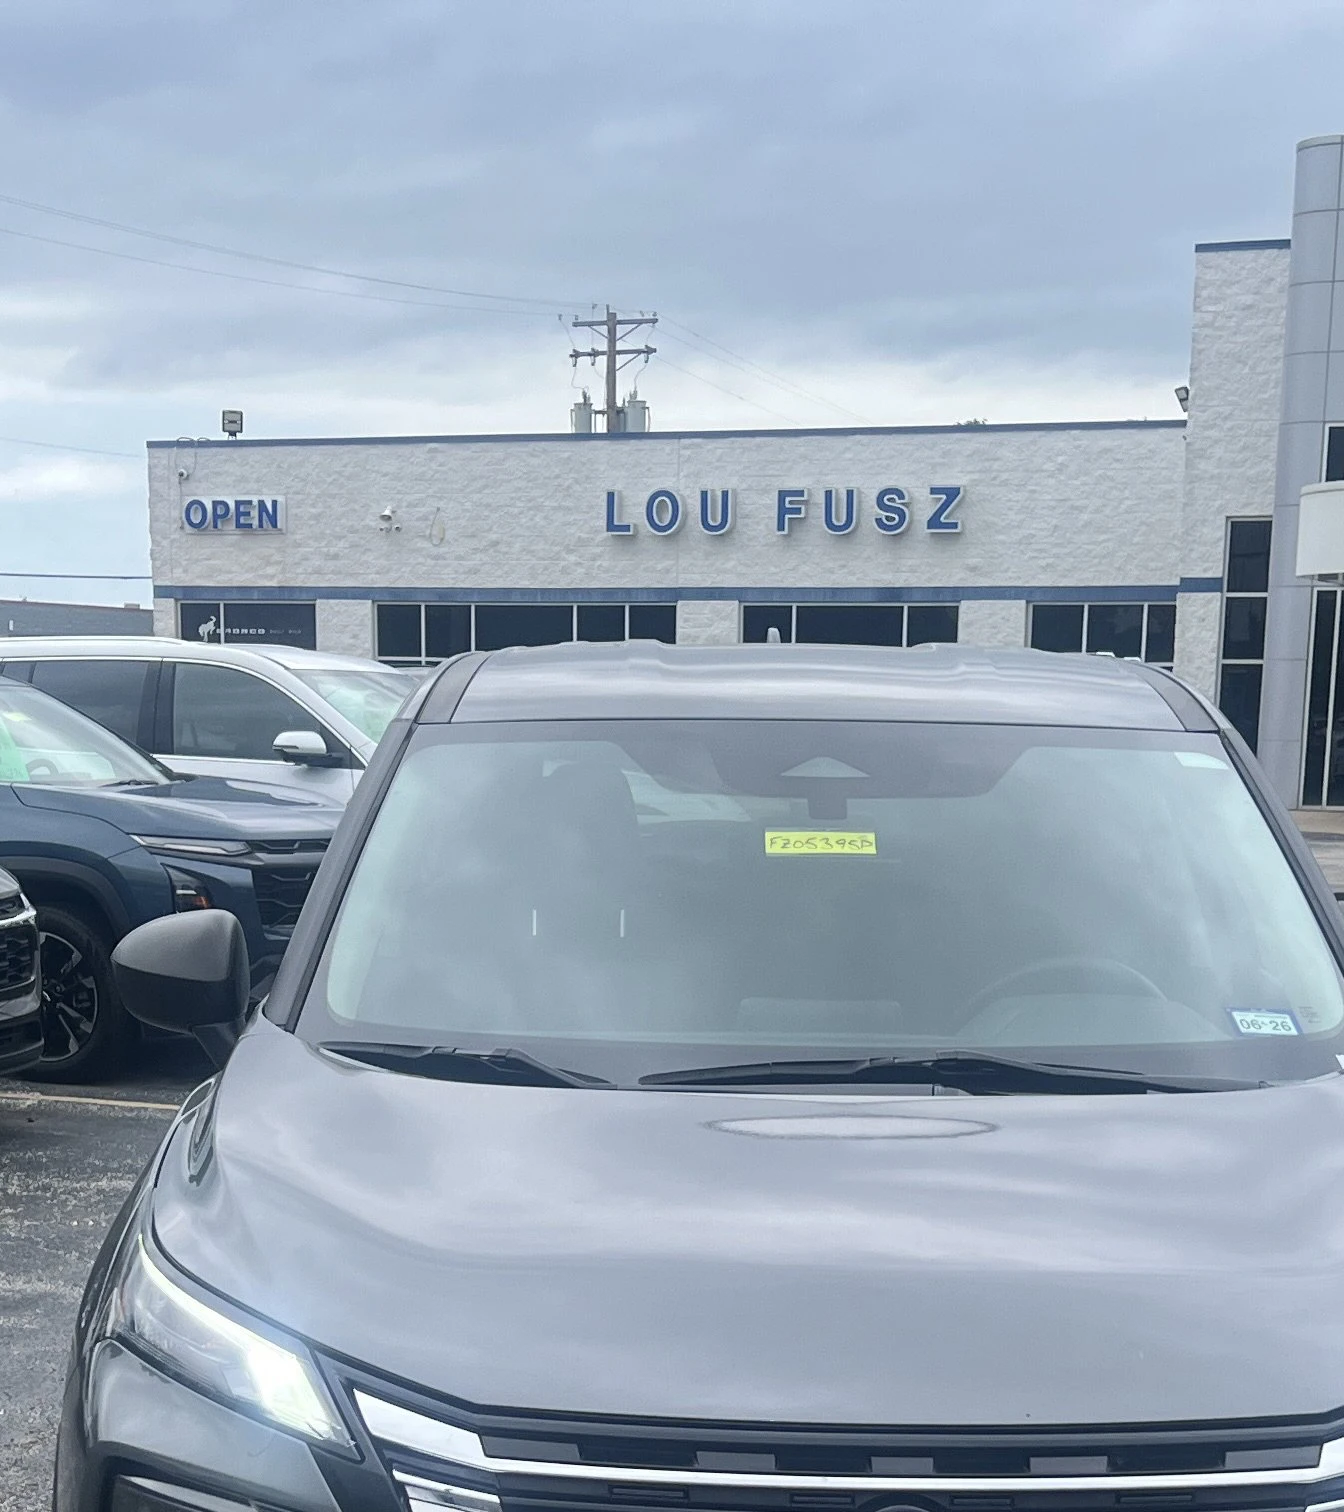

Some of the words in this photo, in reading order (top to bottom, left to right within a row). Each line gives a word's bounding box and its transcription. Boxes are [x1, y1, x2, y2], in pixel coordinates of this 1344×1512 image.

[184, 499, 278, 529] OPEN
[606, 488, 734, 536] LOU
[776, 486, 963, 536] FUSZ
[1239, 1018, 1262, 1030] 06
[1269, 1020, 1292, 1032] 26
